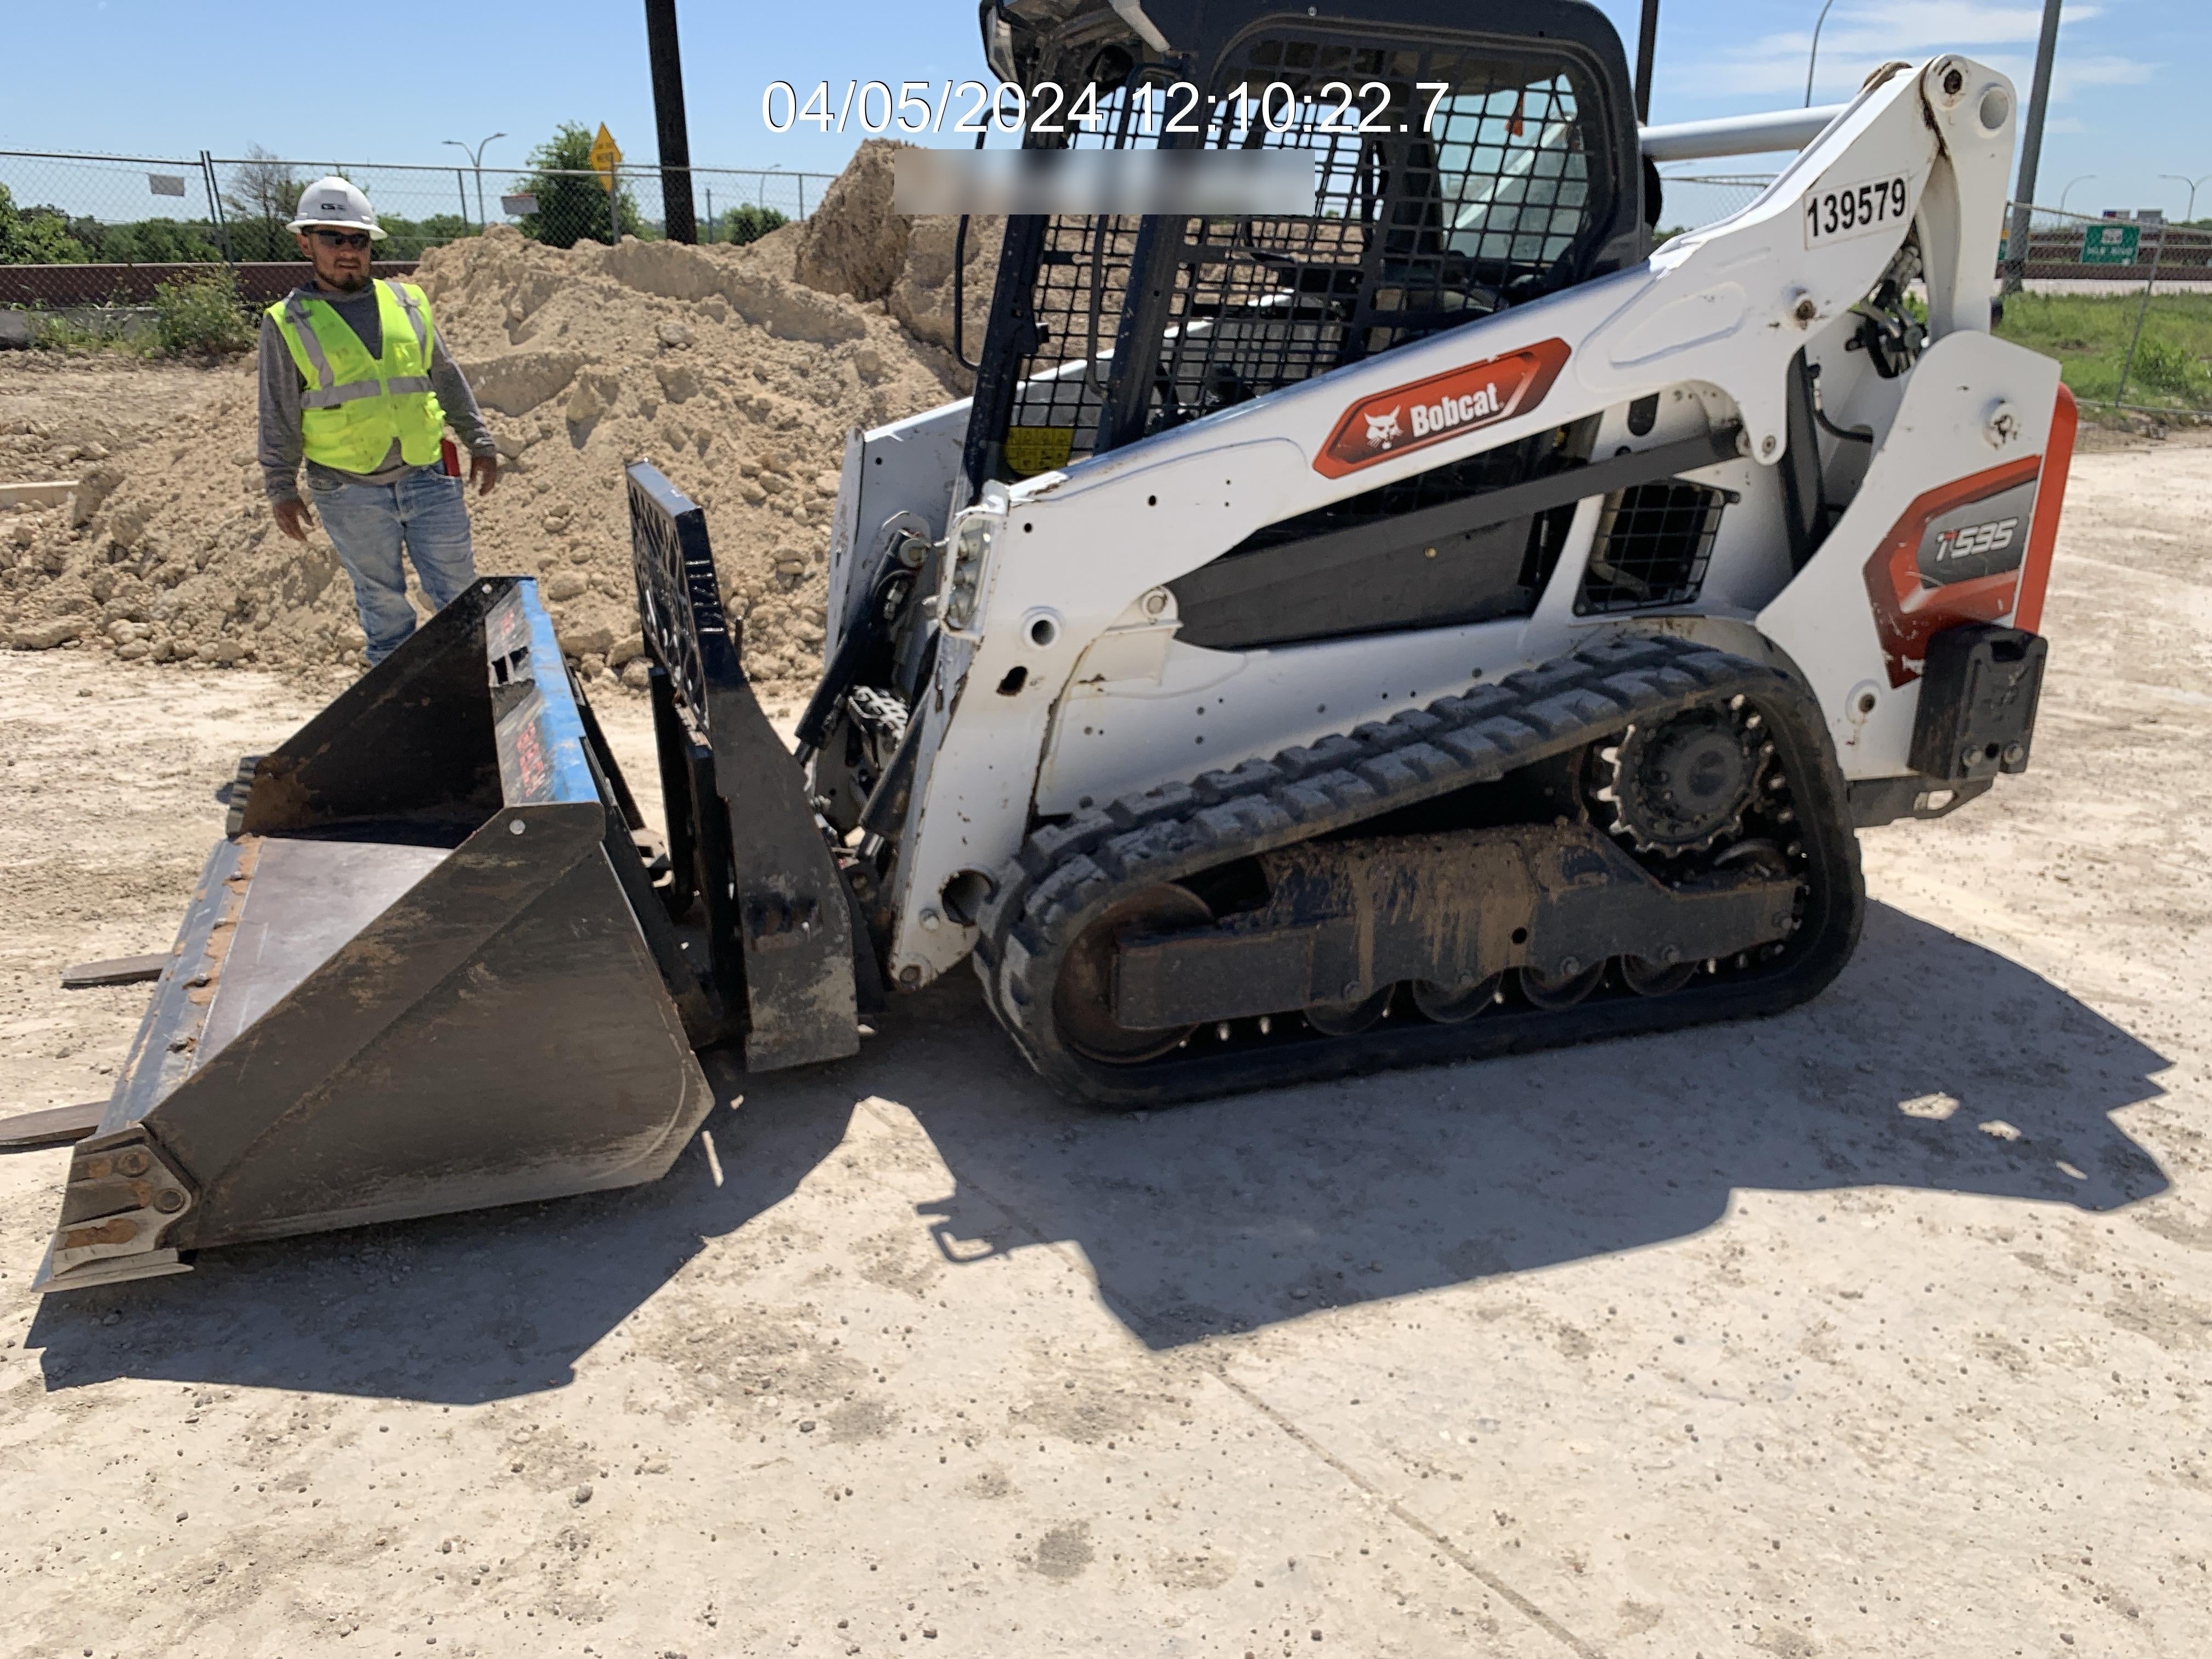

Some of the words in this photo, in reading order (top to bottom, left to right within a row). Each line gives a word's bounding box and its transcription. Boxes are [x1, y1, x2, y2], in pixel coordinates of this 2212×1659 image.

[1807, 177, 1906, 237] 139579
[1410, 382, 1499, 432] Bobcat
[1936, 517, 2019, 562] T595
